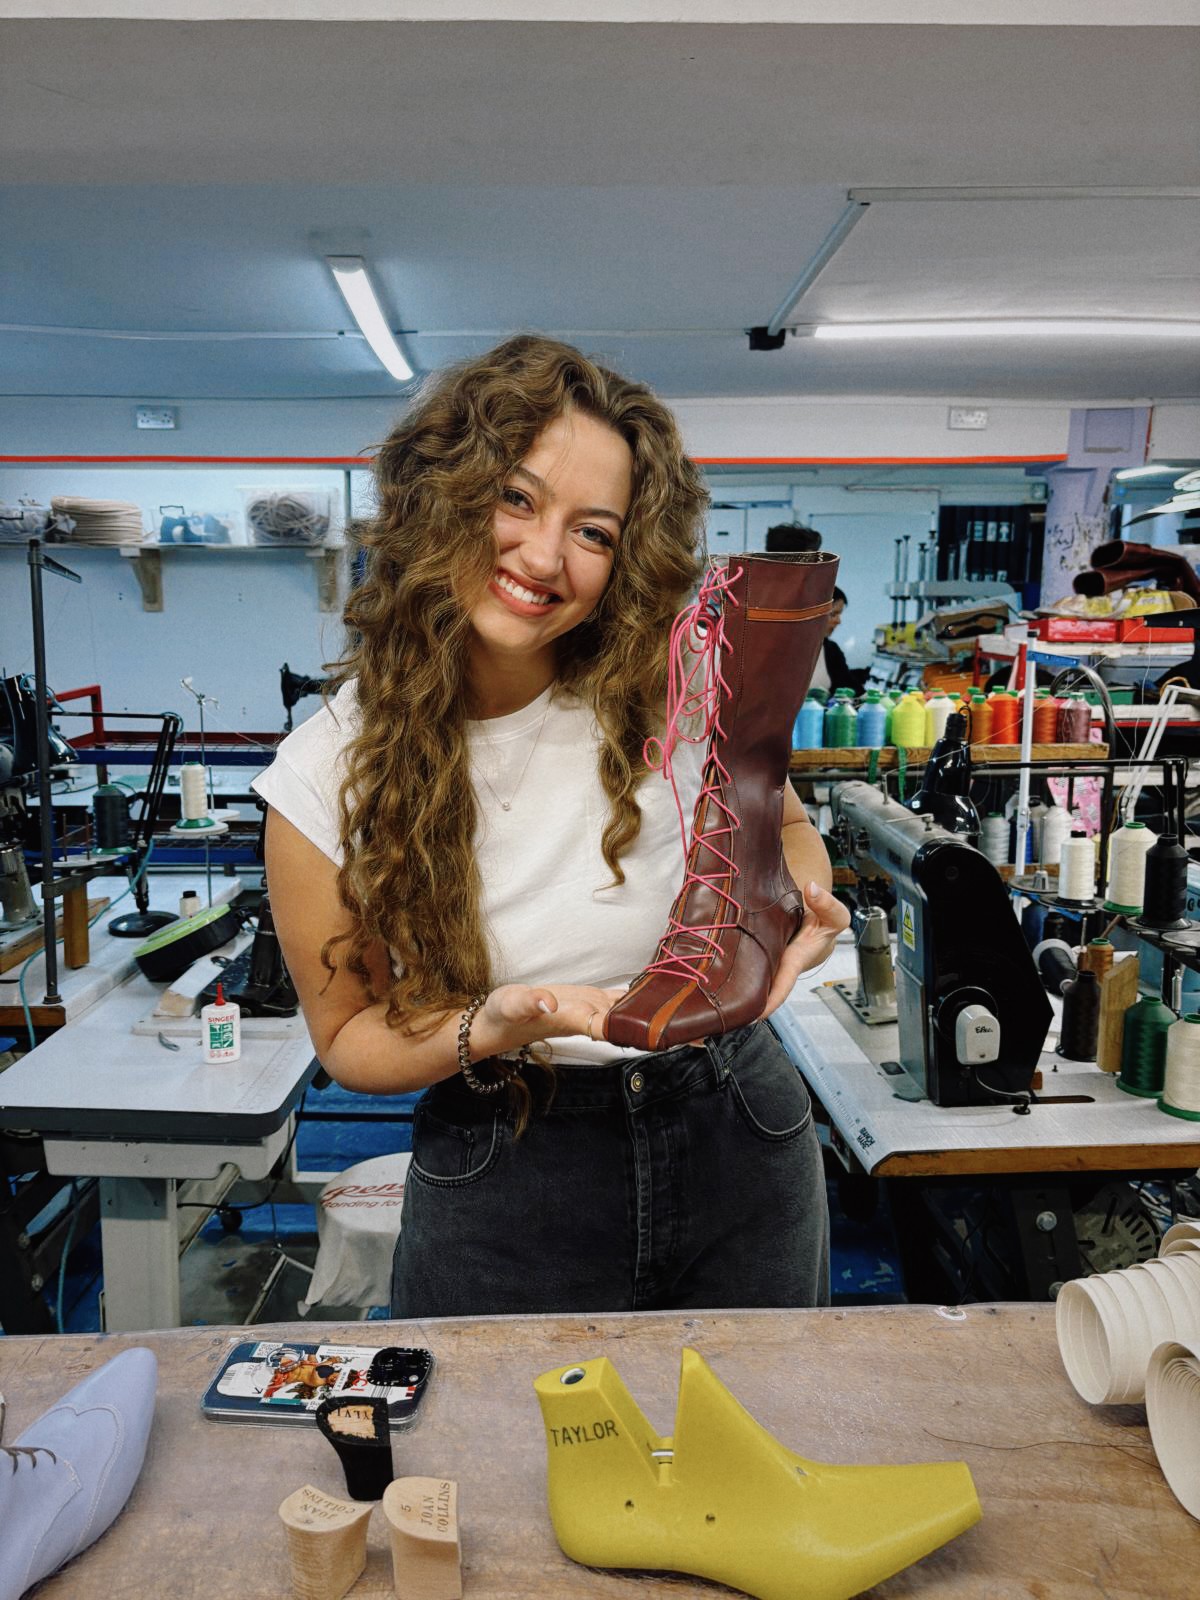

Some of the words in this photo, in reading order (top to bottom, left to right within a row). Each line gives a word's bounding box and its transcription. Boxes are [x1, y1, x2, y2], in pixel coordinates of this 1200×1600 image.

[207, 1015, 236, 1023] SINGER
[550, 1420, 619, 1447] TAYLOR
[300, 1503, 338, 1520] JOAN
[302, 1488, 356, 1514] COLLINS
[421, 1496, 434, 1526] JOAN
[437, 1482, 450, 1533] COLLINS
